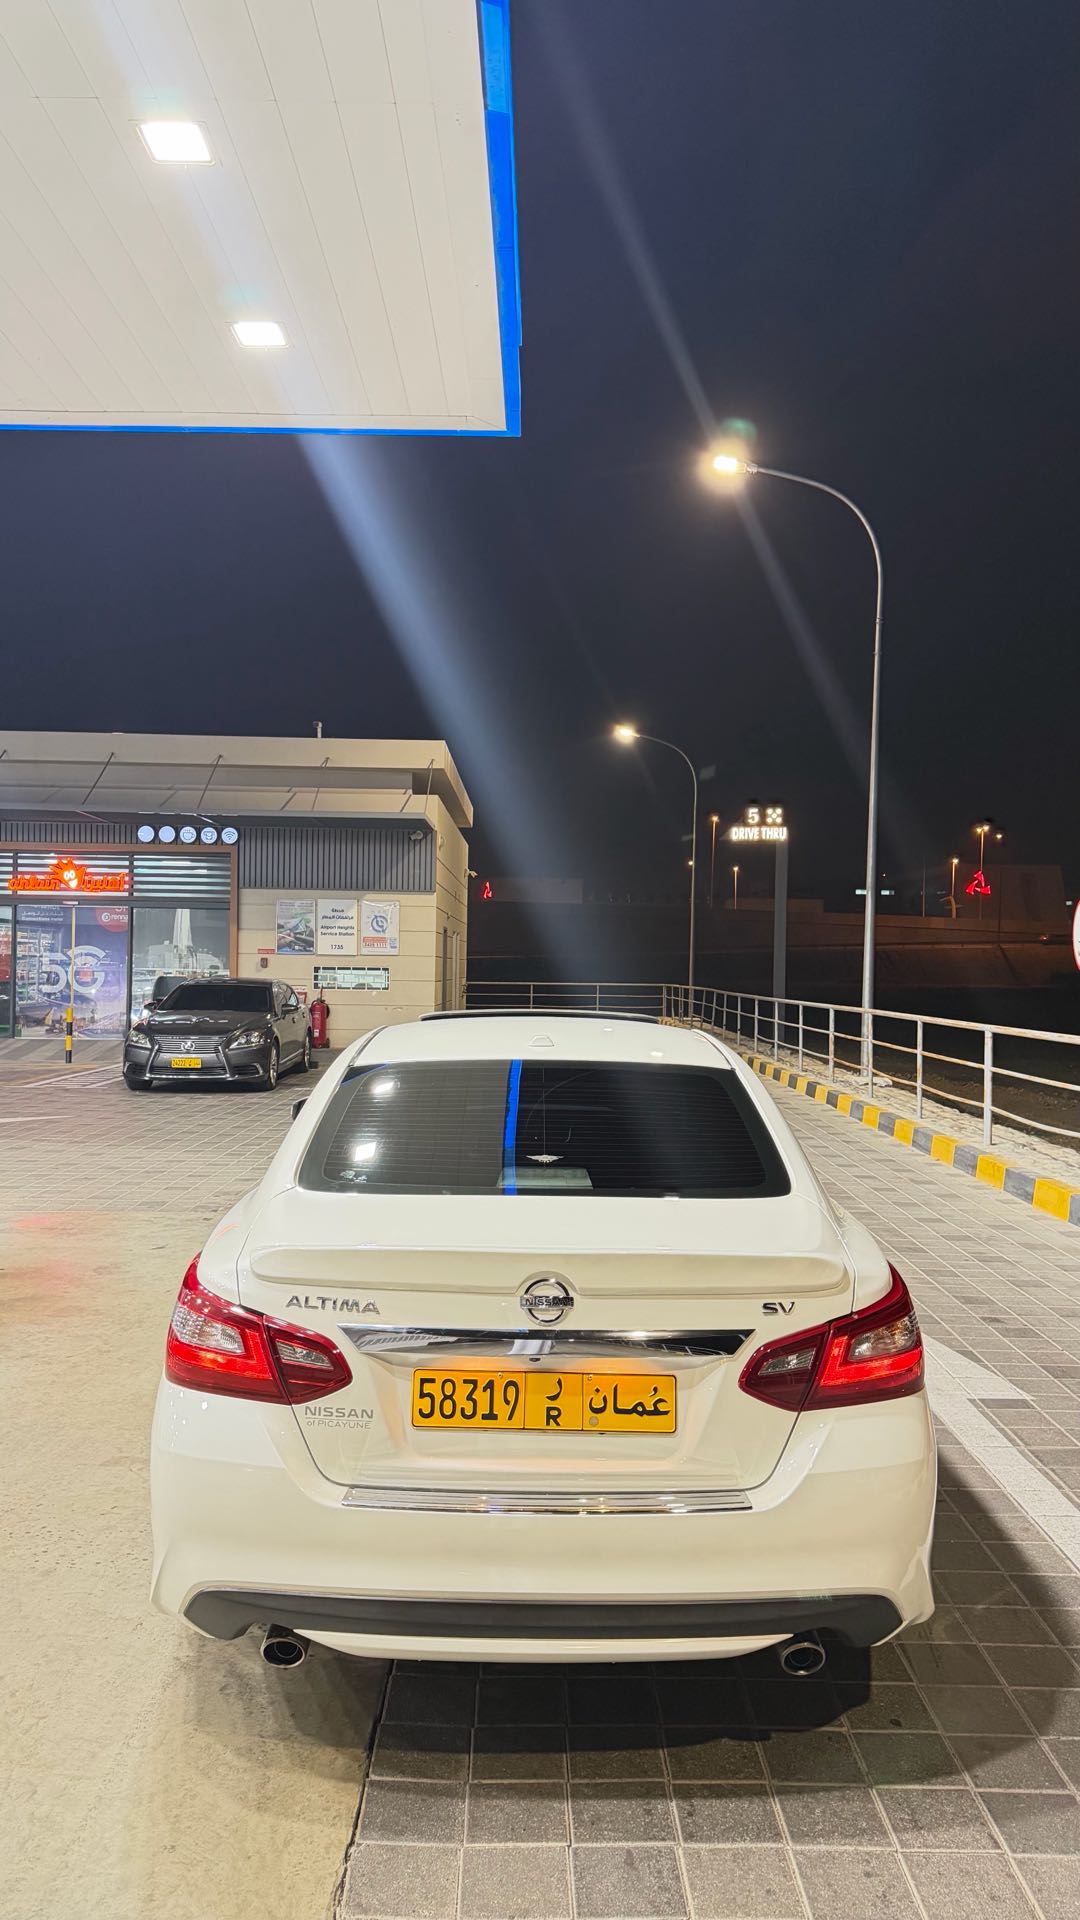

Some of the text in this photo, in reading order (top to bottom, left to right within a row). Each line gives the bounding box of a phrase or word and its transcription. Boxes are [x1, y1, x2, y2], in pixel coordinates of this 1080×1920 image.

[747, 807, 760, 824] 5
[731, 826, 788, 841] DRIVE THRU
[40, 945, 106, 995] 5G
[285, 1295, 381, 1315] ALTIMA
[762, 1301, 796, 1315] SV
[418, 1377, 520, 1421] 58319
[304, 1405, 374, 1419] NISSAN
[545, 1406, 561, 1426] R
[317, 1420, 372, 1430] PICAYUNE
